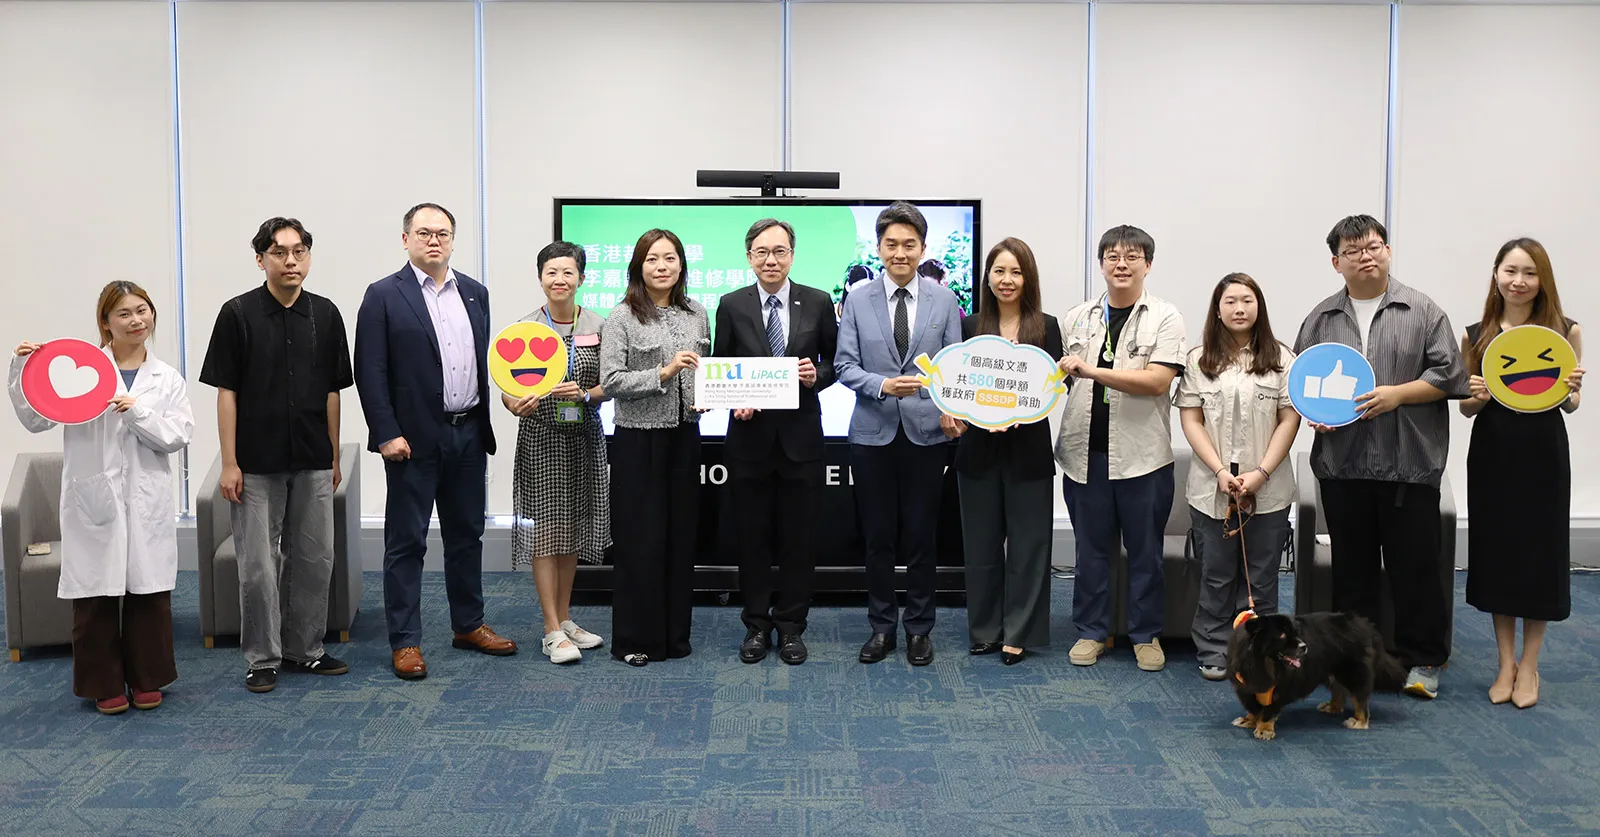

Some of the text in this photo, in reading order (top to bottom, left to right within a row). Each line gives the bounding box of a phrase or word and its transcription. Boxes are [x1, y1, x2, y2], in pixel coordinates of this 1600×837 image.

[962, 353, 1028, 373] 7個高級文憑
[751, 370, 789, 379] LiPACE
[956, 373, 1029, 393] 共580個學額
[941, 386, 1041, 409] 獲政府 SSSDP 資助
